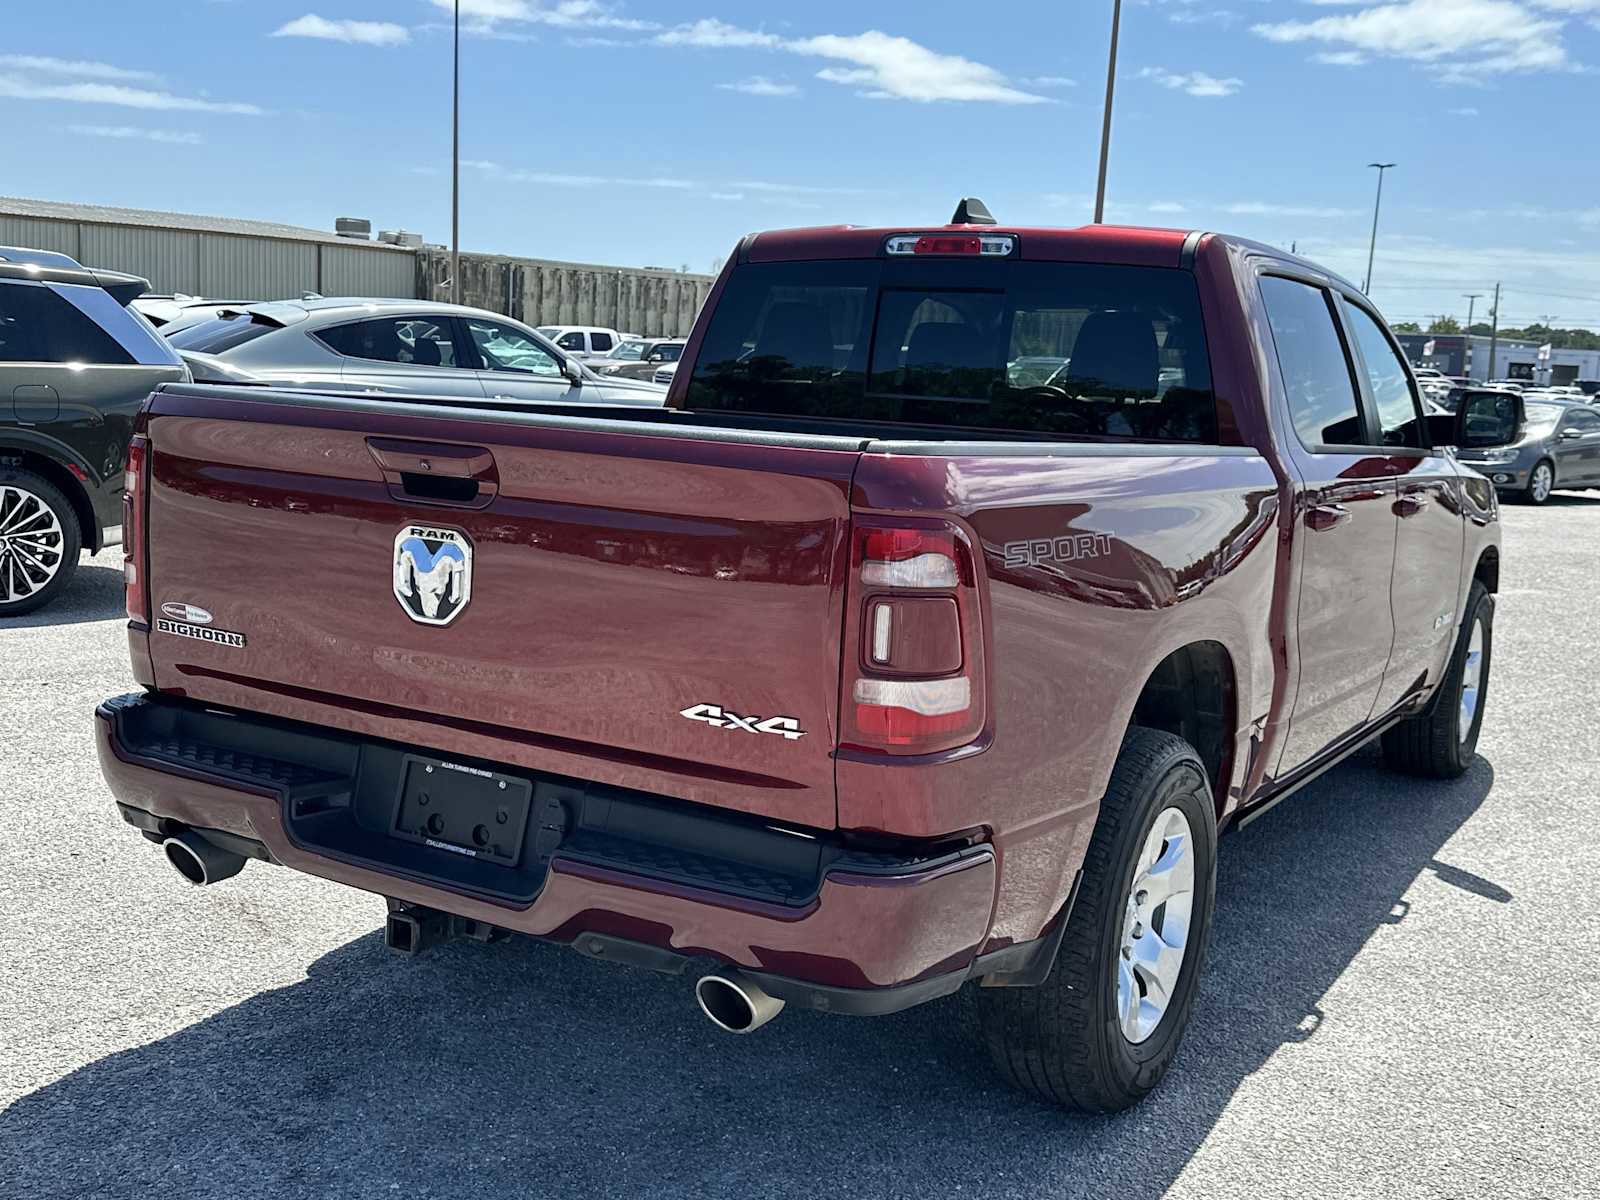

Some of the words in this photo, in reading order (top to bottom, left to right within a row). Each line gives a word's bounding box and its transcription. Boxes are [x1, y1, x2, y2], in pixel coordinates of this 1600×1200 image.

[410, 528, 455, 540] RAM
[1004, 531, 1115, 568] SPORT
[157, 619, 243, 647] BIGHORN
[680, 703, 808, 740] 4x4
